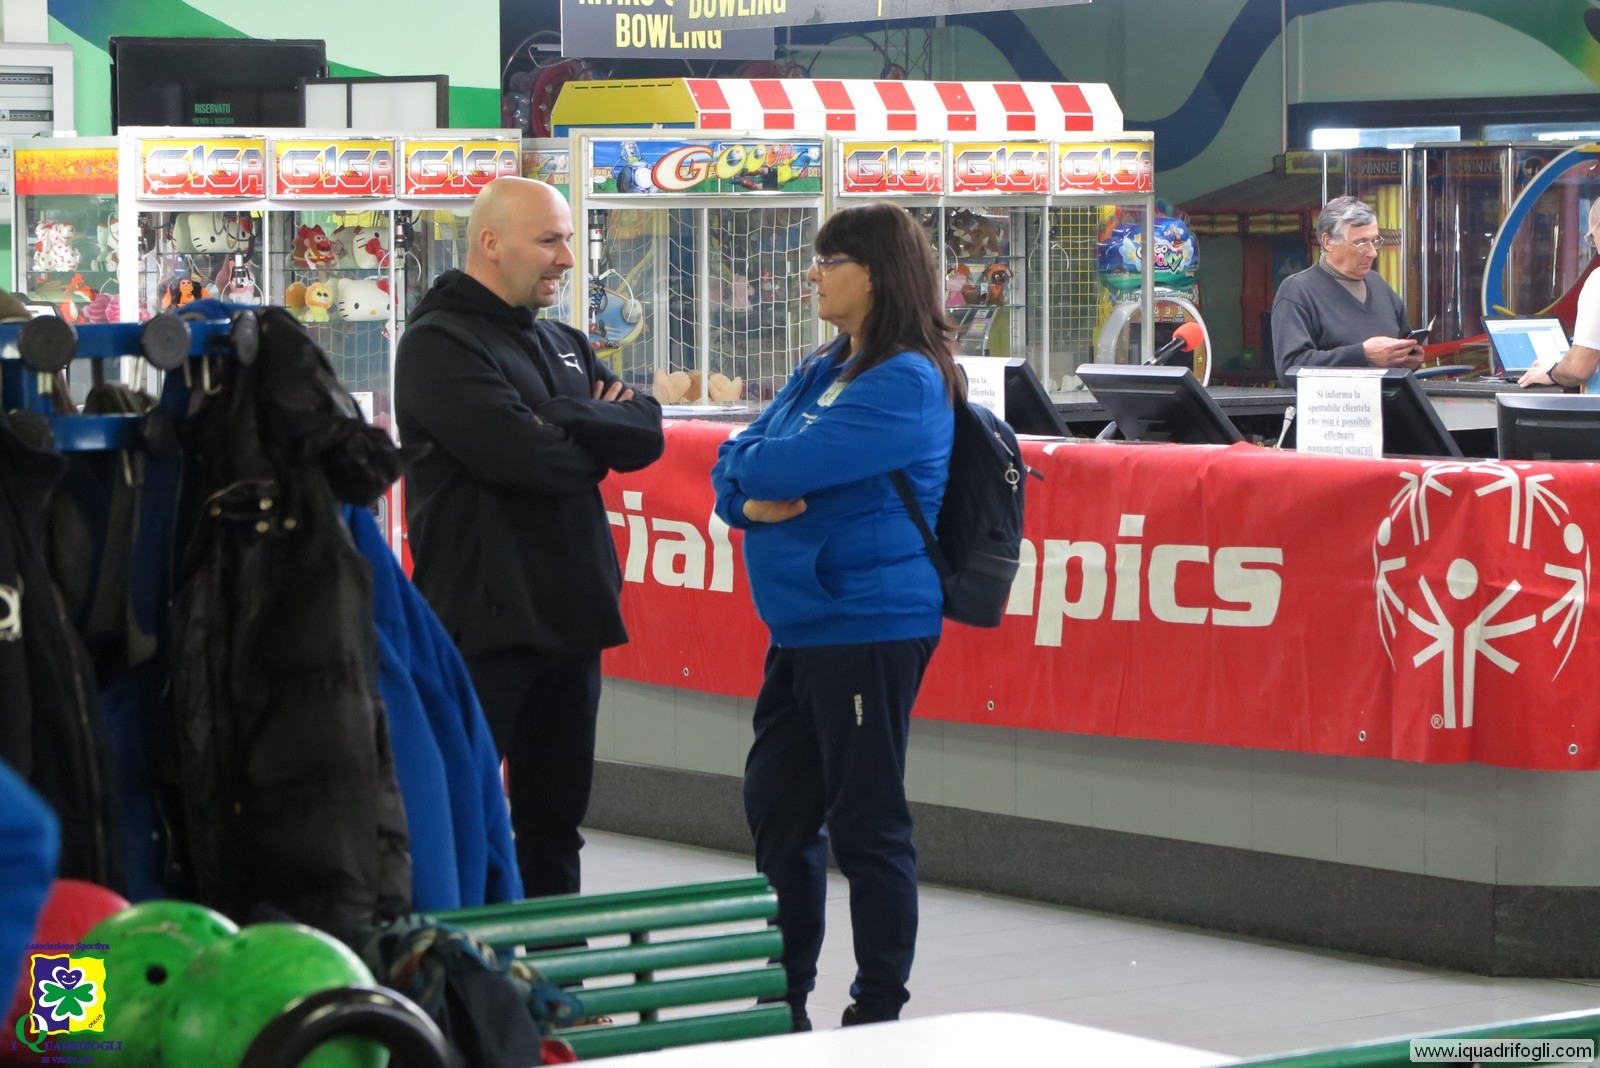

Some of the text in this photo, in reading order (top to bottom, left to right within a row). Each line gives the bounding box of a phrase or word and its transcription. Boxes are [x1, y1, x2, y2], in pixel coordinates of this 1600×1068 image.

[194, 103, 231, 114] RISERVATO
[1360, 161, 1402, 174] WINNE
[1463, 160, 1501, 173] WINNE
[1316, 389, 1361, 399] Si informa la
[1308, 403, 1371, 414] spettabile clientela
[1308, 417, 1320, 425] che
[1321, 418, 1335, 426] non
[1341, 417, 1372, 428] possibile
